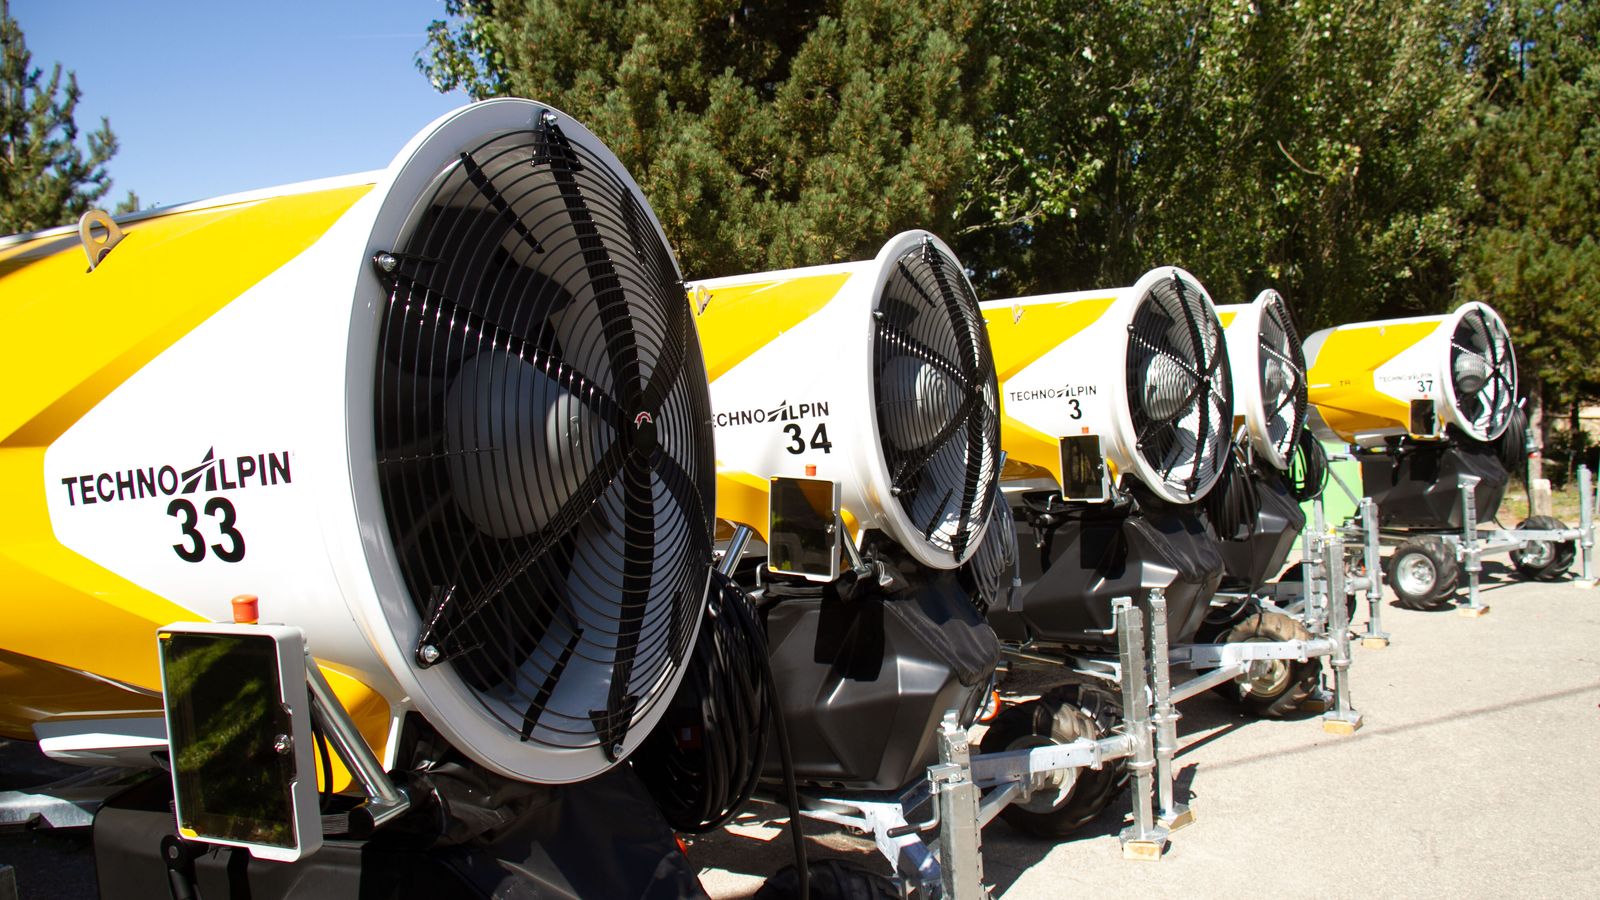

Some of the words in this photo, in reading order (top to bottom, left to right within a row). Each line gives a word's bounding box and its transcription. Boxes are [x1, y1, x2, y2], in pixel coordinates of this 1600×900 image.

[1010, 384, 1097, 402] TECHNOALPIN
[1417, 379, 1433, 393] 37
[712, 400, 829, 428] CHNOALPIN
[1068, 399, 1083, 420] 3
[783, 423, 833, 455] 34
[61, 446, 292, 506] TECHNOALPIN
[166, 496, 246, 563] 33
